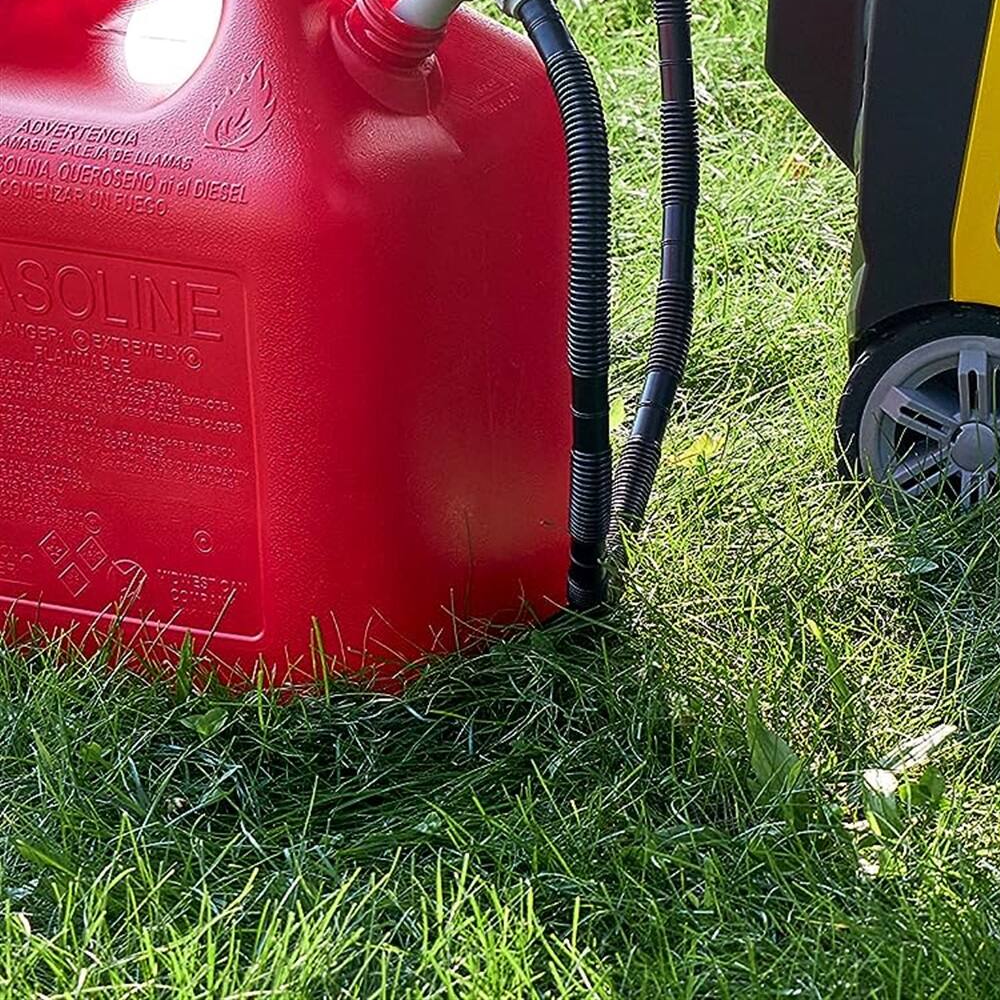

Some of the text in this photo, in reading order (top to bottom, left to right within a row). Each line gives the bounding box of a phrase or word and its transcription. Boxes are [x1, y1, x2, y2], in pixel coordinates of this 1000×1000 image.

[15, 119, 140, 148] ADVERTENCIA
[134, 150, 194, 172] LLAMAS
[58, 162, 156, 193] QUEROSENO
[194, 179, 249, 205] DIESEL
[115, 193, 169, 217] FUEGO
